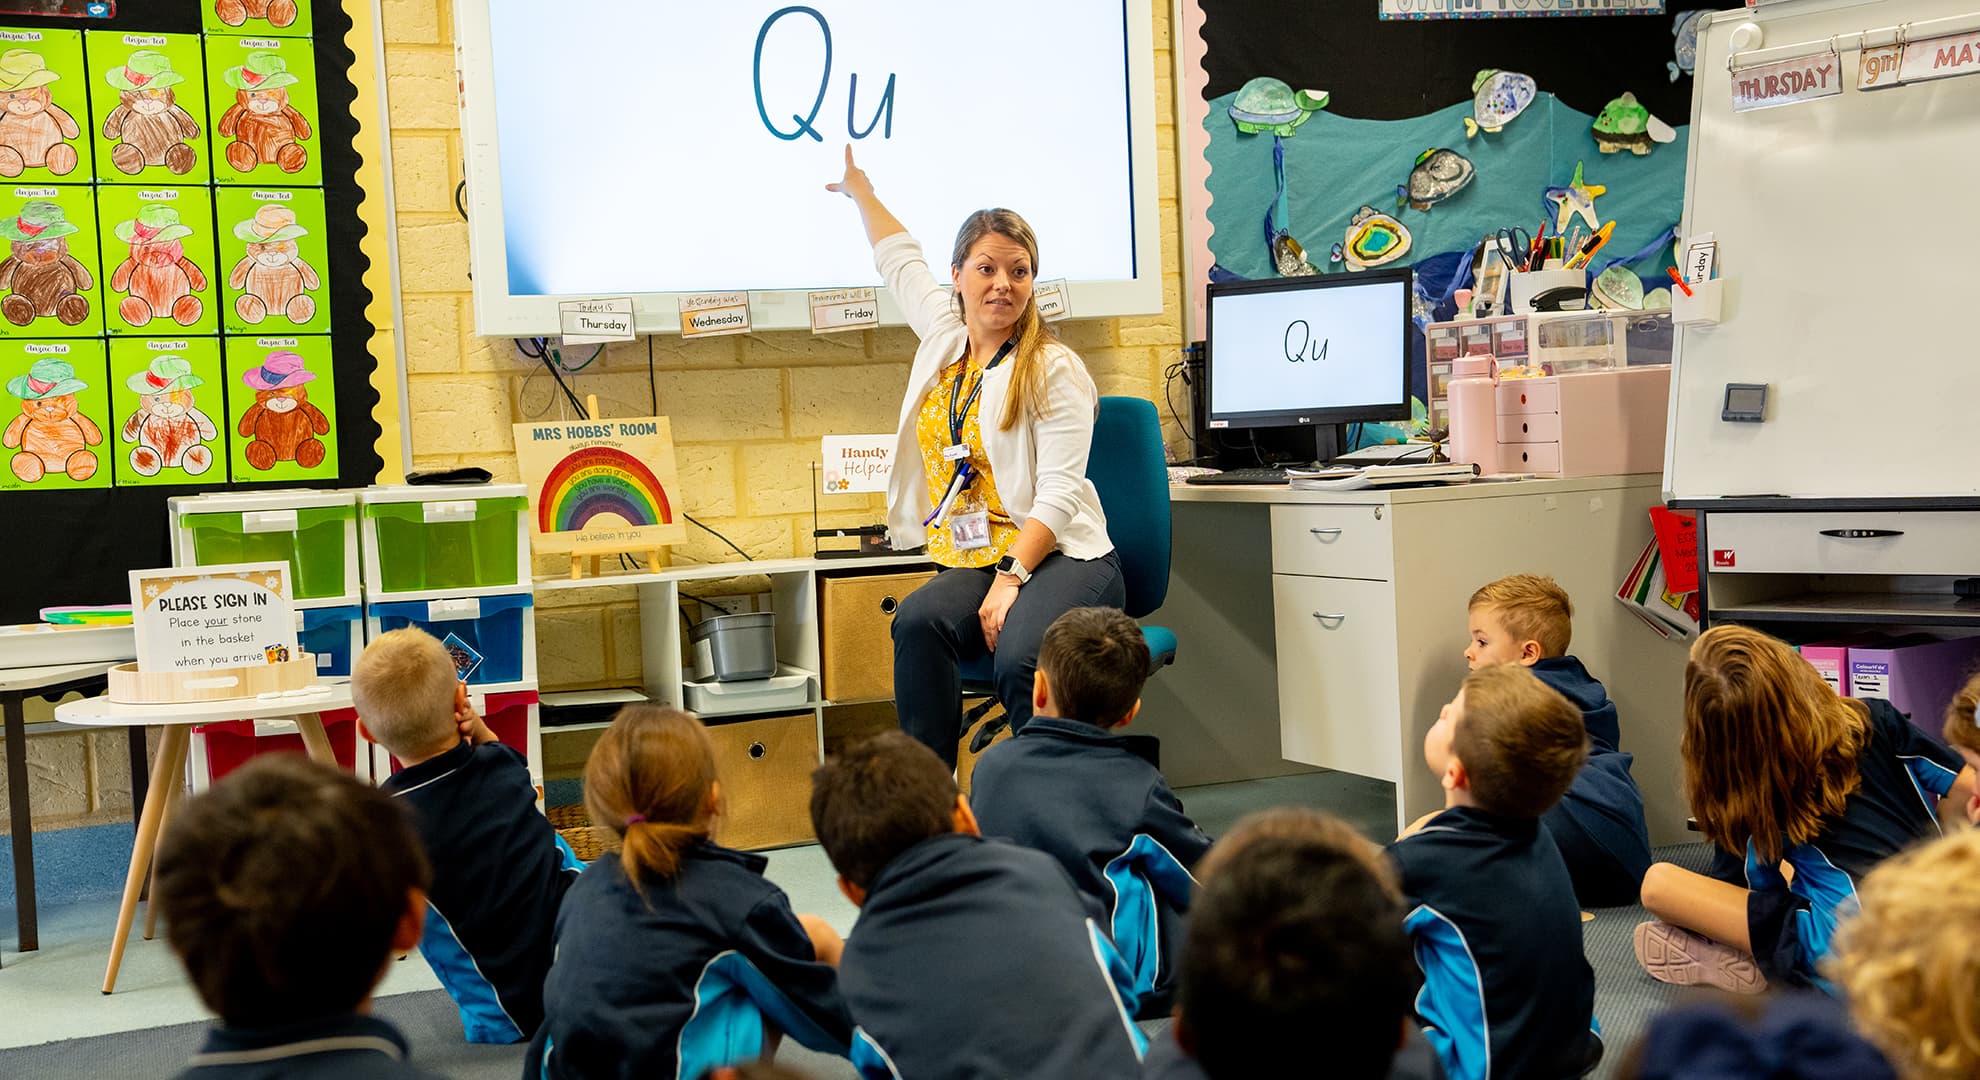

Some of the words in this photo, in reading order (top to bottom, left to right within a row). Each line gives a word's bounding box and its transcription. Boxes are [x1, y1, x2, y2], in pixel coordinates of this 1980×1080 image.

[753, 5, 896, 143] Qu
[1865, 53, 1898, 84] 9TH
[1738, 63, 1833, 104] THURSDAY
[689, 313, 744, 328] Wednesday
[844, 307, 874, 319] Friday
[580, 317, 627, 332] Thursday
[1284, 319, 1329, 363] Qu
[533, 427, 562, 441] MRS
[567, 423, 615, 439] HOBBS'
[619, 422, 657, 436] ROOM
[591, 440, 624, 448] remember
[841, 447, 888, 460] Handy
[568, 474, 579, 485] you
[580, 470, 593, 478] are
[593, 468, 612, 476] doing
[614, 470, 633, 481] great
[844, 458, 891, 480] Helper
[626, 531, 641, 541] you
[159, 595, 208, 612] PLEASE
[214, 593, 248, 609] SIGN
[253, 591, 267, 606] IN
[169, 616, 200, 629] Place
[204, 618, 228, 628] your
[232, 613, 262, 625] stone
[181, 638, 192, 648] in
[196, 635, 215, 646] the
[219, 632, 255, 645] basket
[174, 655, 205, 667] when
[209, 656, 228, 667] you
[233, 651, 264, 663] arrive
